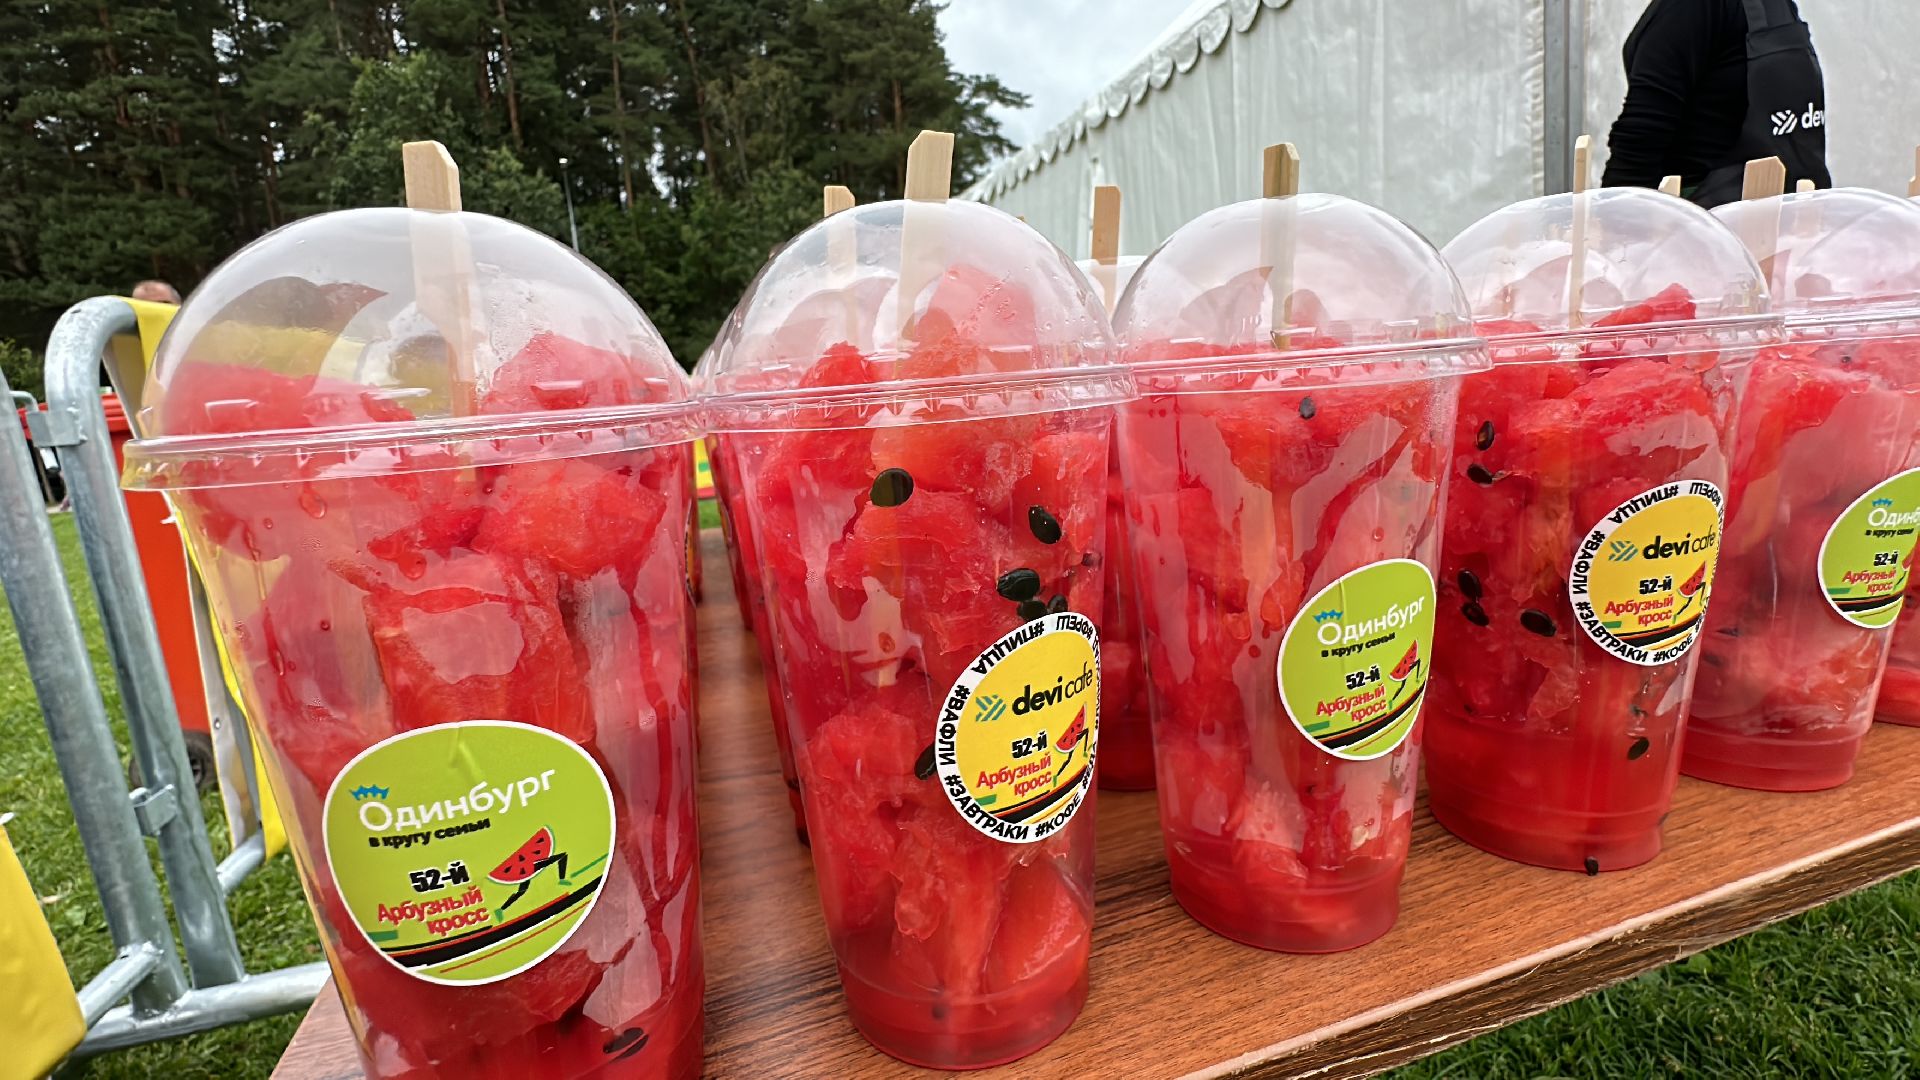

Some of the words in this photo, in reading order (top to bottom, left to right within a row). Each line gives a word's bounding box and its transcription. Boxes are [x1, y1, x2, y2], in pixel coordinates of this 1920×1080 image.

[1608, 484, 1679, 525] #ПИЦЦА
[1643, 533, 1691, 560] devi
[1692, 524, 1717, 553] cafe
[1573, 530, 1606, 595] #ВАФЛИ
[1842, 567, 1897, 585] Арбузный
[1604, 594, 1674, 616] Арбузный
[1866, 581, 1894, 595] кросс
[1317, 596, 1425, 645] Одинбург
[1575, 601, 1648, 663] #ЗАВТРАКИ
[1638, 609, 1673, 627] кросс
[971, 620, 1045, 676] #ПИЦЦА
[1321, 650, 1329, 658] в
[1331, 641, 1364, 658] кругу
[1652, 635, 1694, 663] #КОФЕ
[1012, 676, 1063, 716] devi
[1064, 661, 1094, 699] cafe
[1316, 684, 1386, 717] Арбузный
[938, 684, 971, 766] #ВАФЛИ
[1351, 699, 1388, 723] кросс
[976, 751, 1052, 790] Арбузный
[1014, 770, 1053, 798] кросс
[359, 769, 556, 832] Одинбург
[943, 774, 1029, 840] #ЗАВТРАКИ
[1034, 792, 1081, 838] #КОФЕ
[368, 837, 380, 848] в
[382, 831, 431, 849] кругу
[434, 818, 491, 840] семьи
[377, 885, 484, 927] Арбузный
[426, 907, 490, 937] кросс
